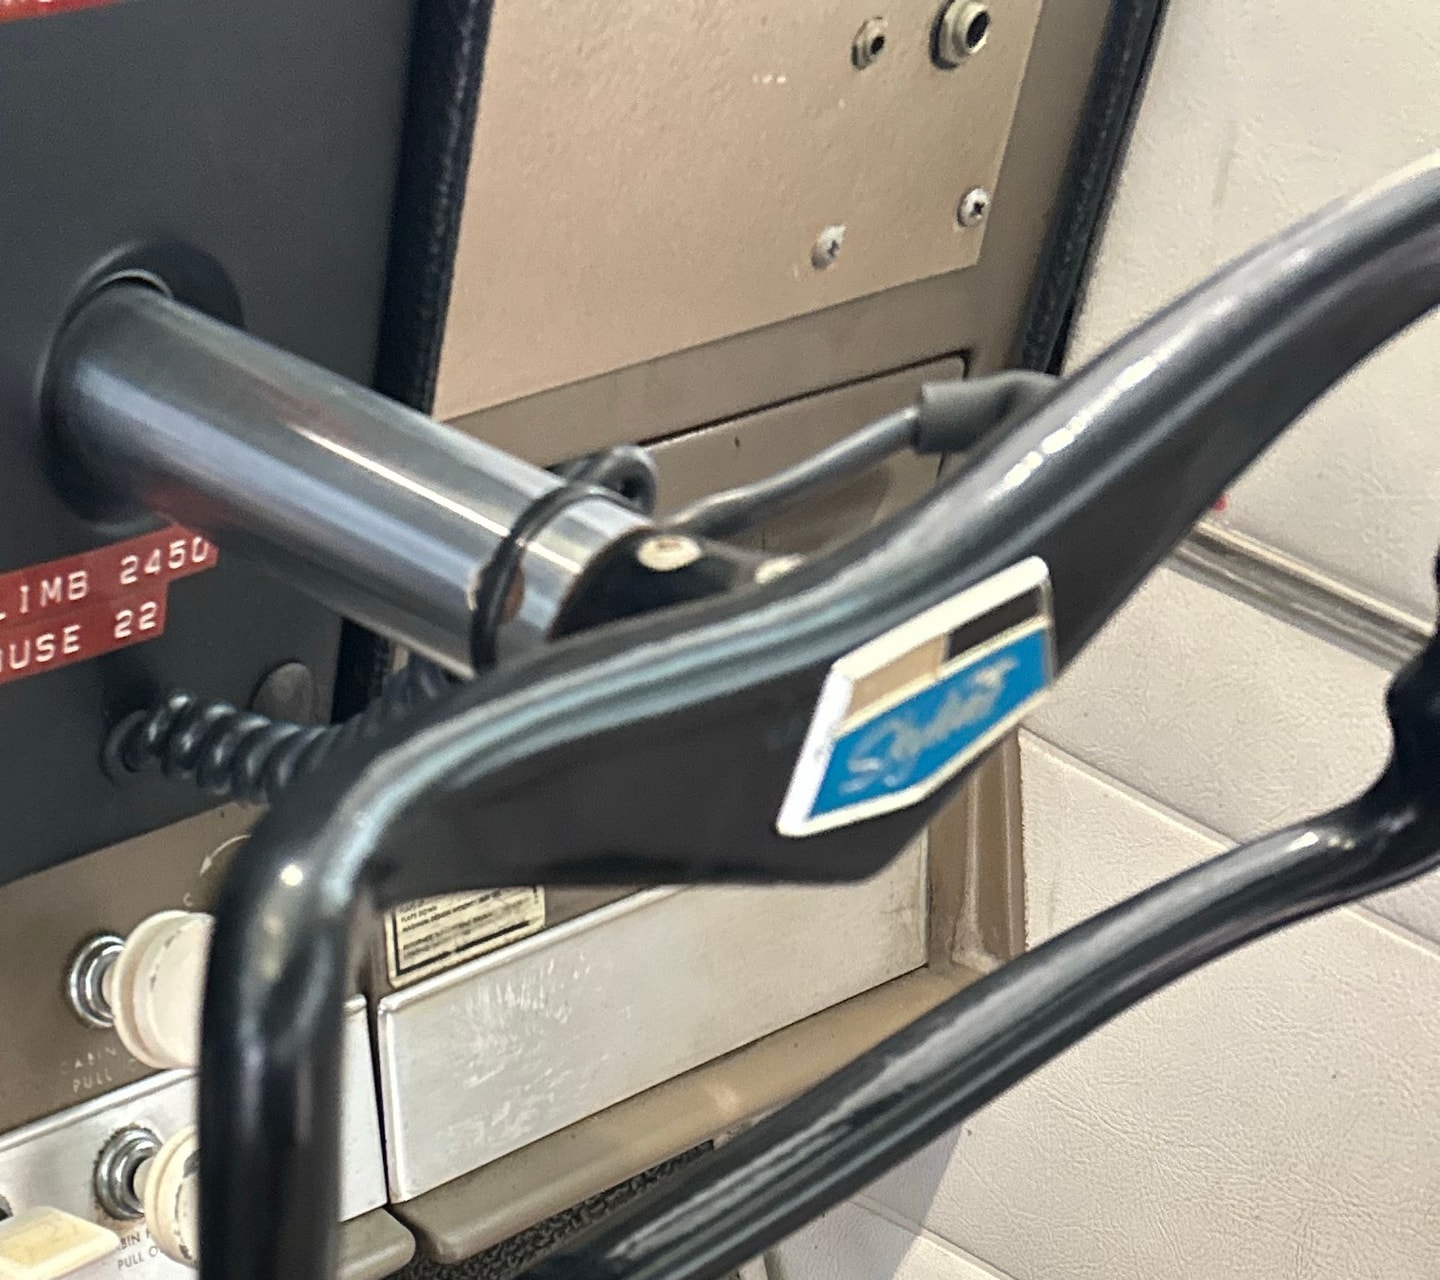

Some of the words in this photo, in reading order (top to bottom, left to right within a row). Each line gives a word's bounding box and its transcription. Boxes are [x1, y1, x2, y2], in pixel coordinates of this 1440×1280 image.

[118, 536, 210, 586] 2450
[113, 601, 159, 640] 22
[117, 1251, 145, 1271] PULL
